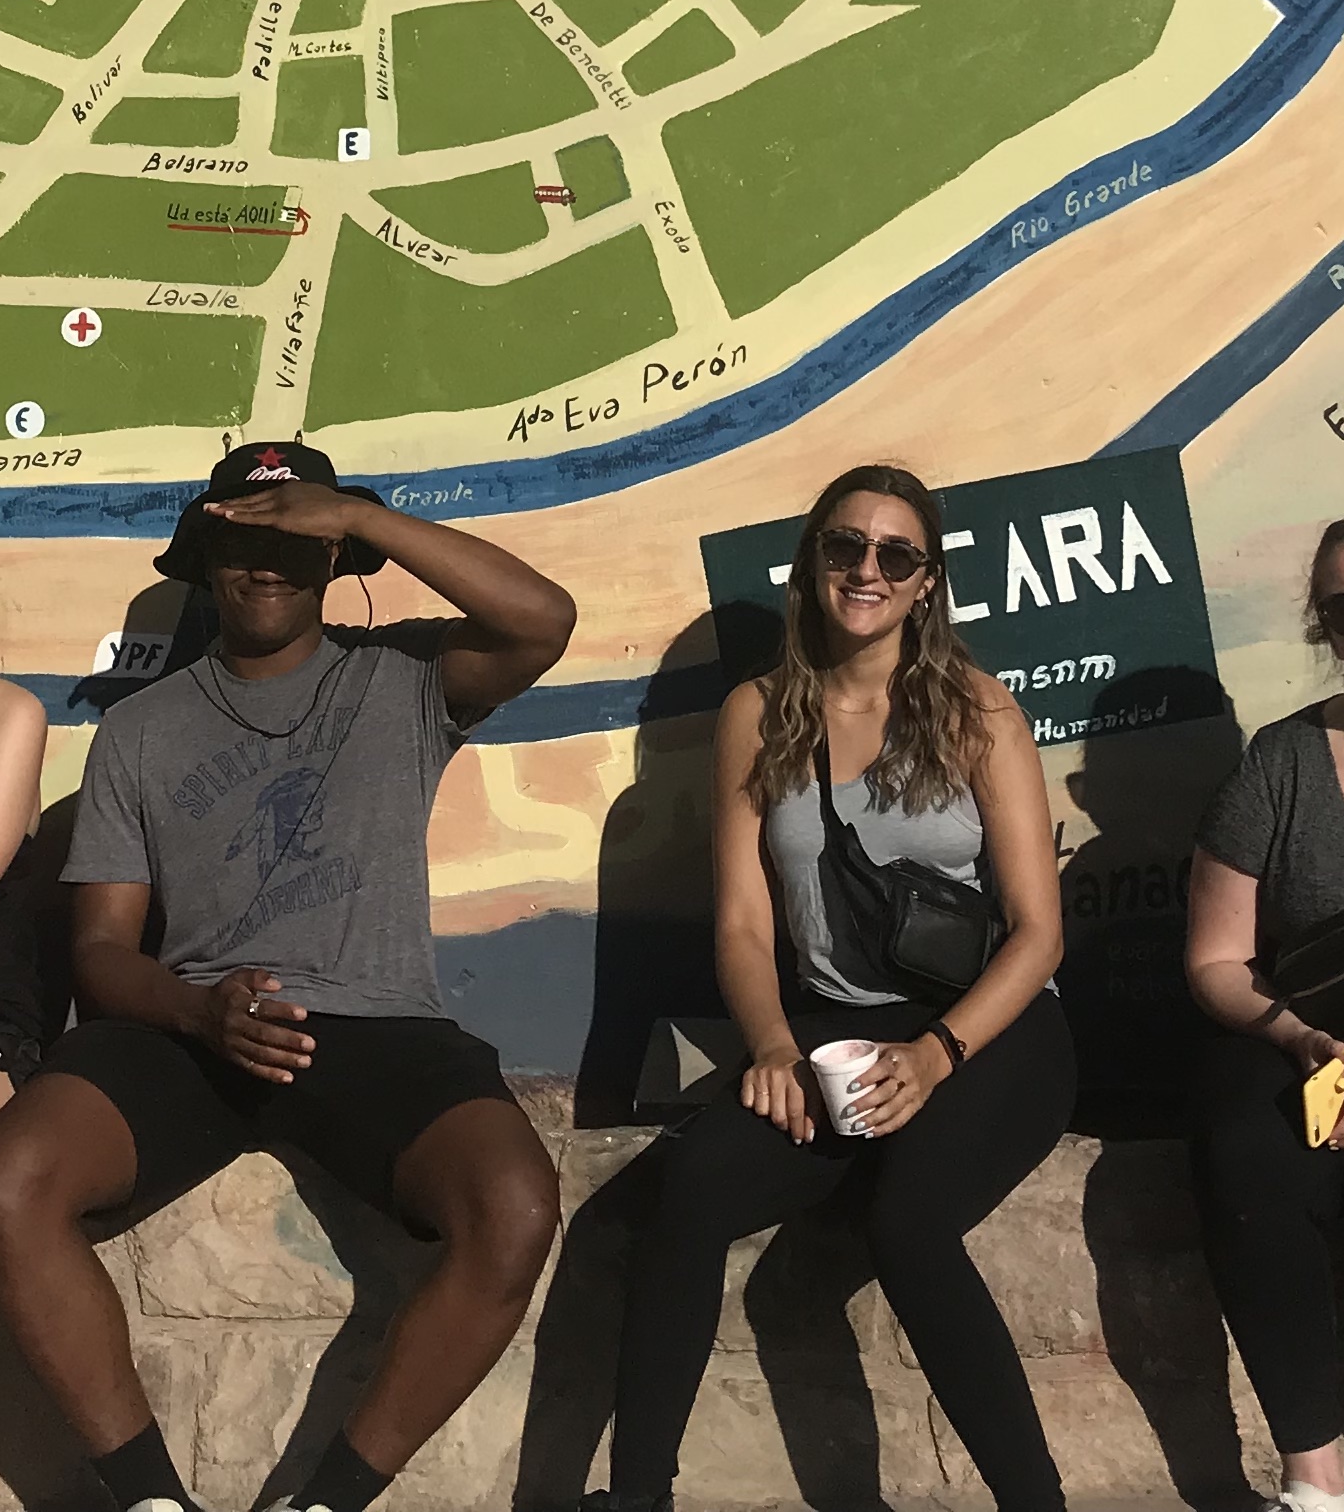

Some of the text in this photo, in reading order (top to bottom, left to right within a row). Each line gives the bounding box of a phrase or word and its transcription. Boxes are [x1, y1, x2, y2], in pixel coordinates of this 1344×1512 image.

[251, 1, 283, 82] Padilla
[528, 1, 633, 111] De Benedetti
[71, 54, 123, 125] Bolivar
[141, 151, 249, 176] Belgrano
[344, 130, 359, 157] E
[194, 203, 231, 224] está
[1064, 159, 1153, 218] Grande
[654, 199, 691, 255] Exodo
[146, 283, 240, 309] Lavalle
[564, 395, 621, 433] Eva
[641, 342, 748, 403] Perón
[389, 481, 474, 509] Grande
[769, 500, 1174, 625] CARA
[109, 641, 164, 671] YPF
[996, 654, 1116, 693] msnm
[1033, 695, 1168, 742] Humanidad
[173, 735, 272, 821] SPIRIT
